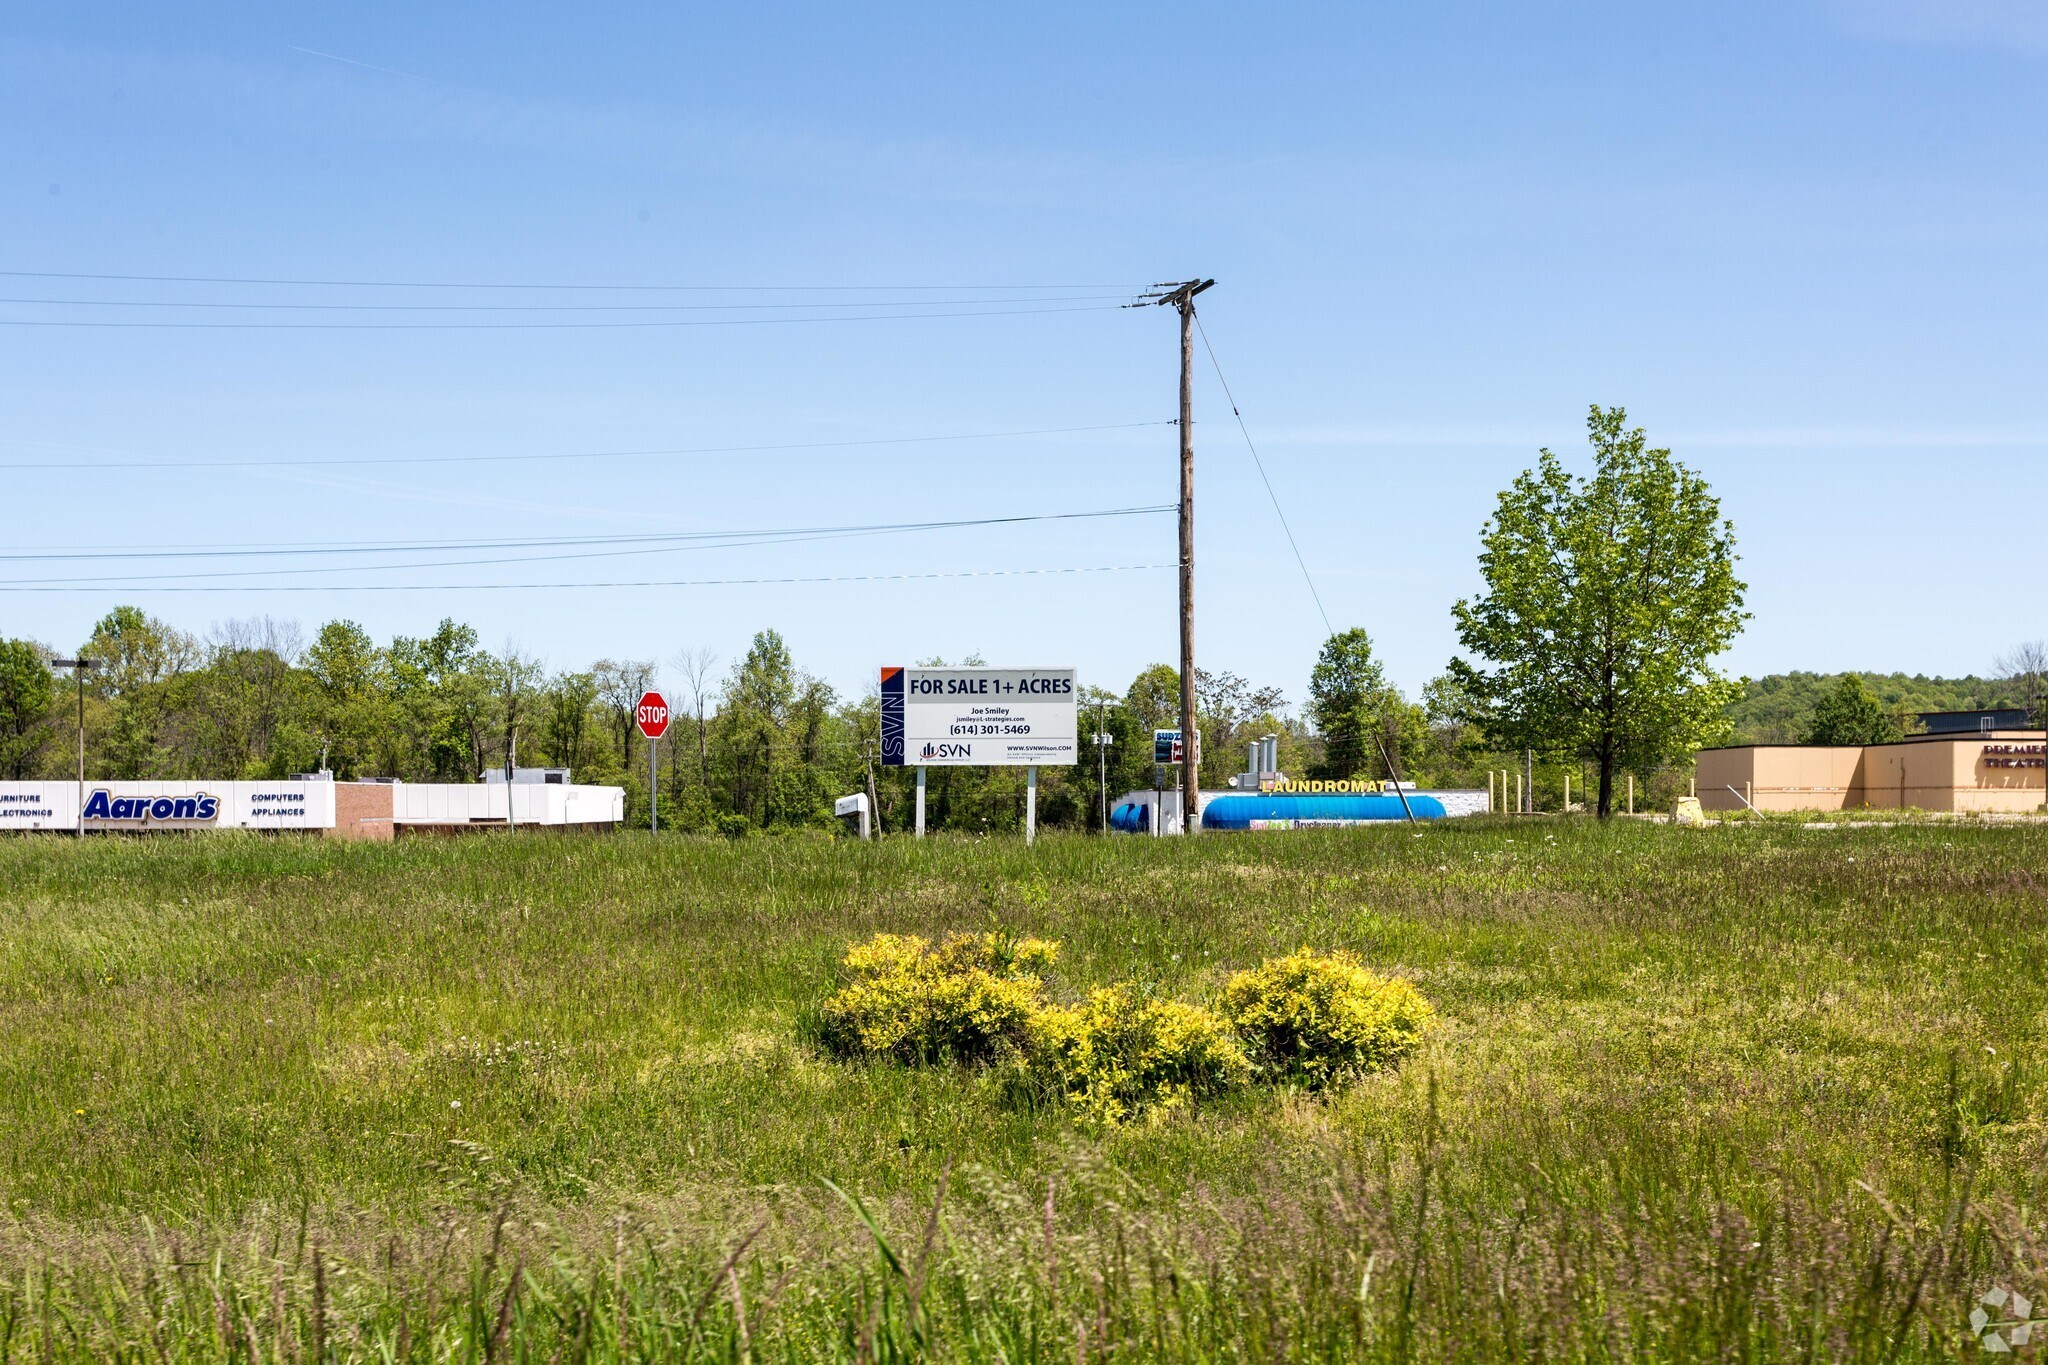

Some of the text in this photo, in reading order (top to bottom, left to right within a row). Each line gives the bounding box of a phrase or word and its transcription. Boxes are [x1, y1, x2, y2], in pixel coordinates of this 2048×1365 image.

[911, 678, 1071, 694] FOR SALE 1+ ACRES
[639, 705, 667, 724] STOP
[971, 707, 1010, 716] Joe Smiley
[881, 692, 904, 756] SVN
[950, 724, 1031, 736] (614) 301-5469
[939, 743, 971, 757] SVN
[1261, 780, 1387, 793] LAUNDROMAT
[251, 794, 305, 802] COMPUTERS
[82, 790, 218, 820] Aaron's
[251, 808, 305, 816] APPLIANCES
